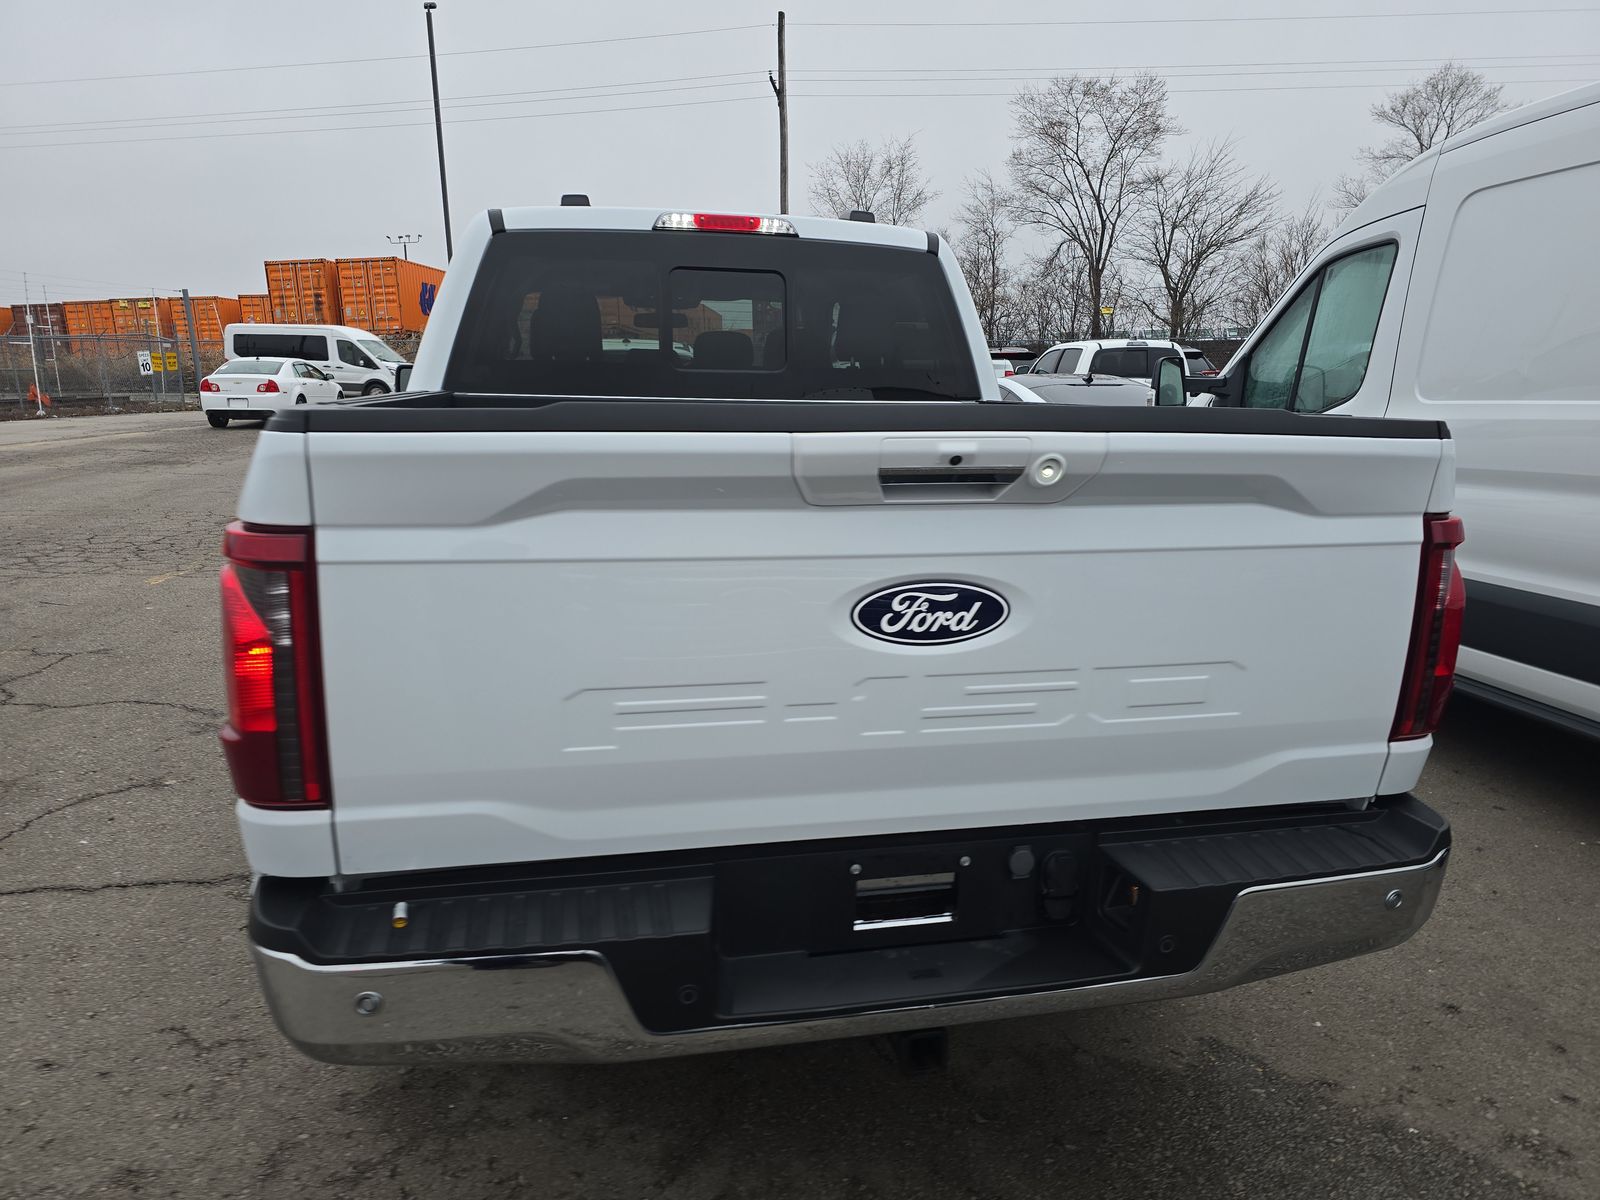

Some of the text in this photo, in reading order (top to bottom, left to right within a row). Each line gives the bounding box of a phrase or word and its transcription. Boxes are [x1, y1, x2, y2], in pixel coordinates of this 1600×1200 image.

[140, 362, 151, 372] 10
[880, 591, 983, 633] Ford
[562, 660, 1248, 752] F-150
